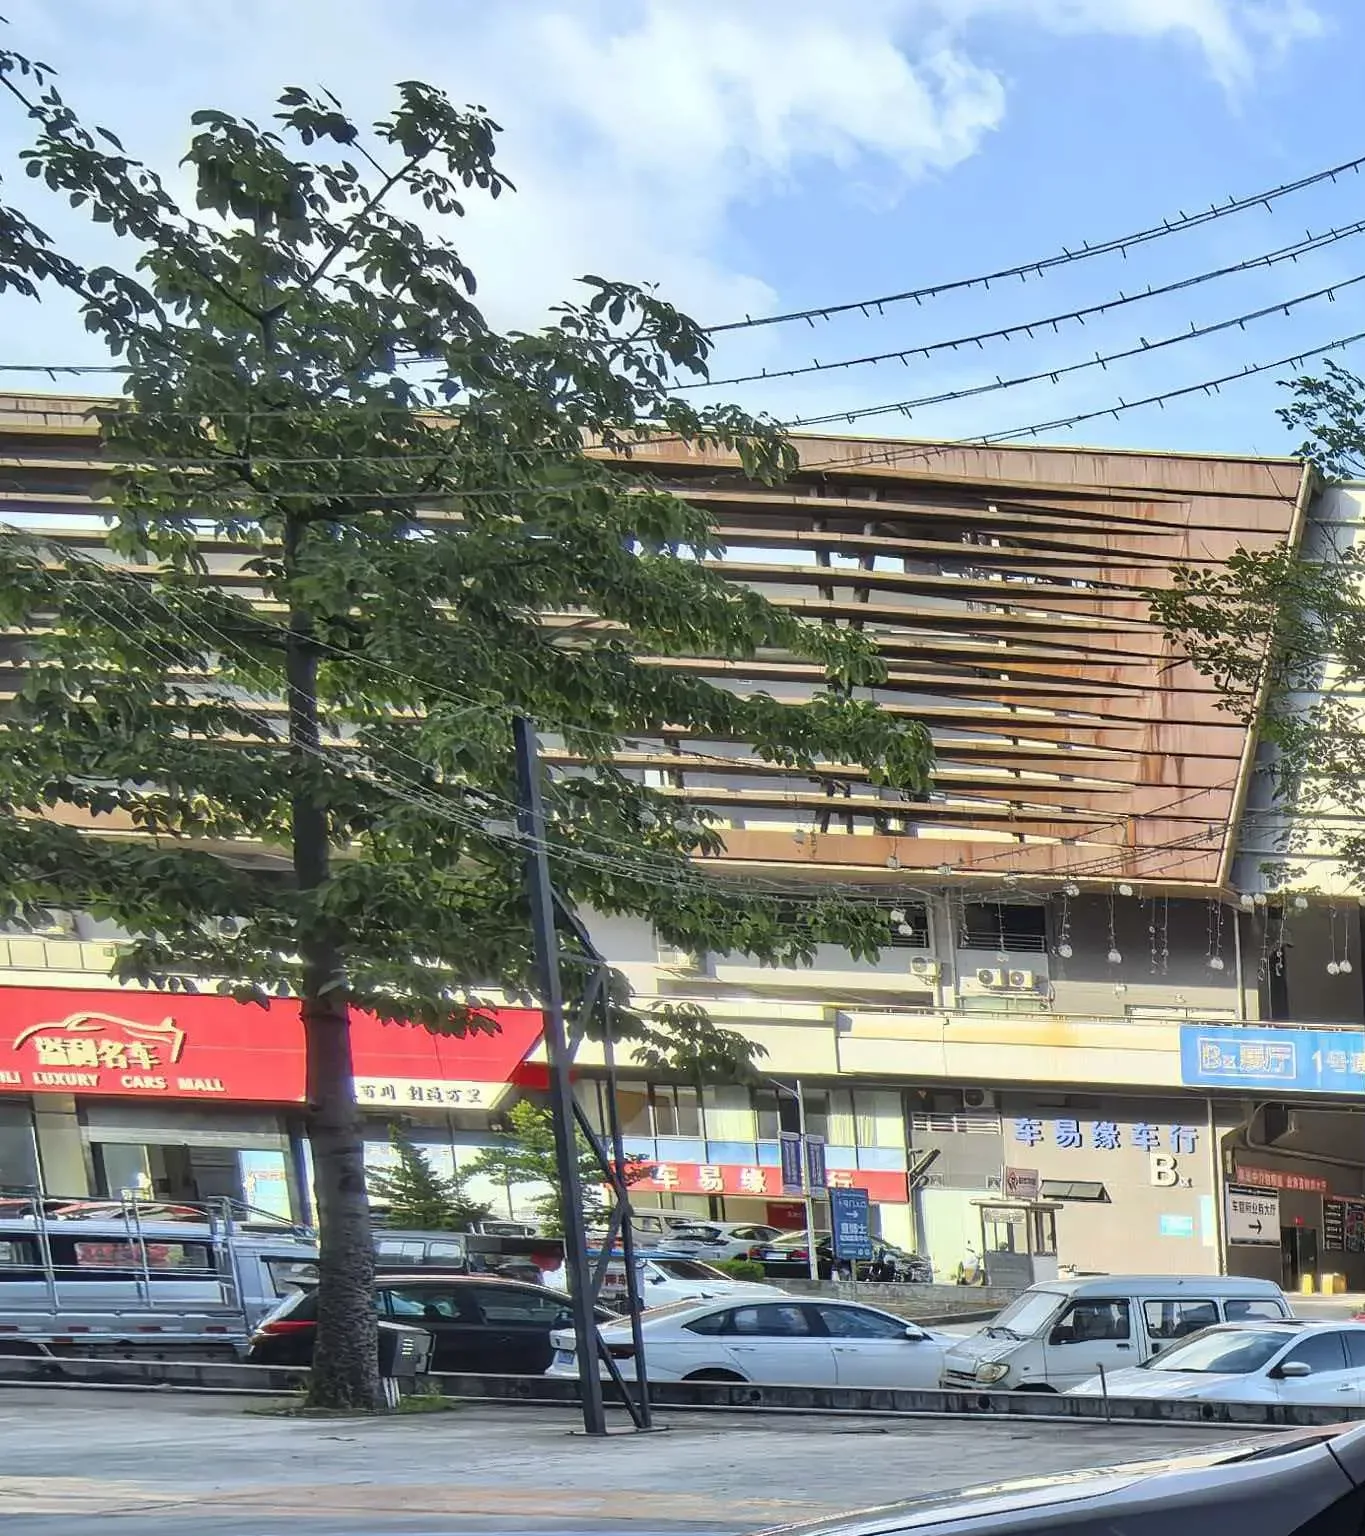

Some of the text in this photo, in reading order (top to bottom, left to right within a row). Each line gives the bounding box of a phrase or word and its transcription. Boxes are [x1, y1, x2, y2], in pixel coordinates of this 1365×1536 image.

[33, 1072, 99, 1088] LUXURY
[120, 1075, 168, 1090] CARS
[177, 1077, 225, 1093] MALL
[353, 1083, 396, 1101] 百川
[1014, 1118, 1199, 1153] 车易缘车行
[651, 1163, 855, 1190] 车易缘行
